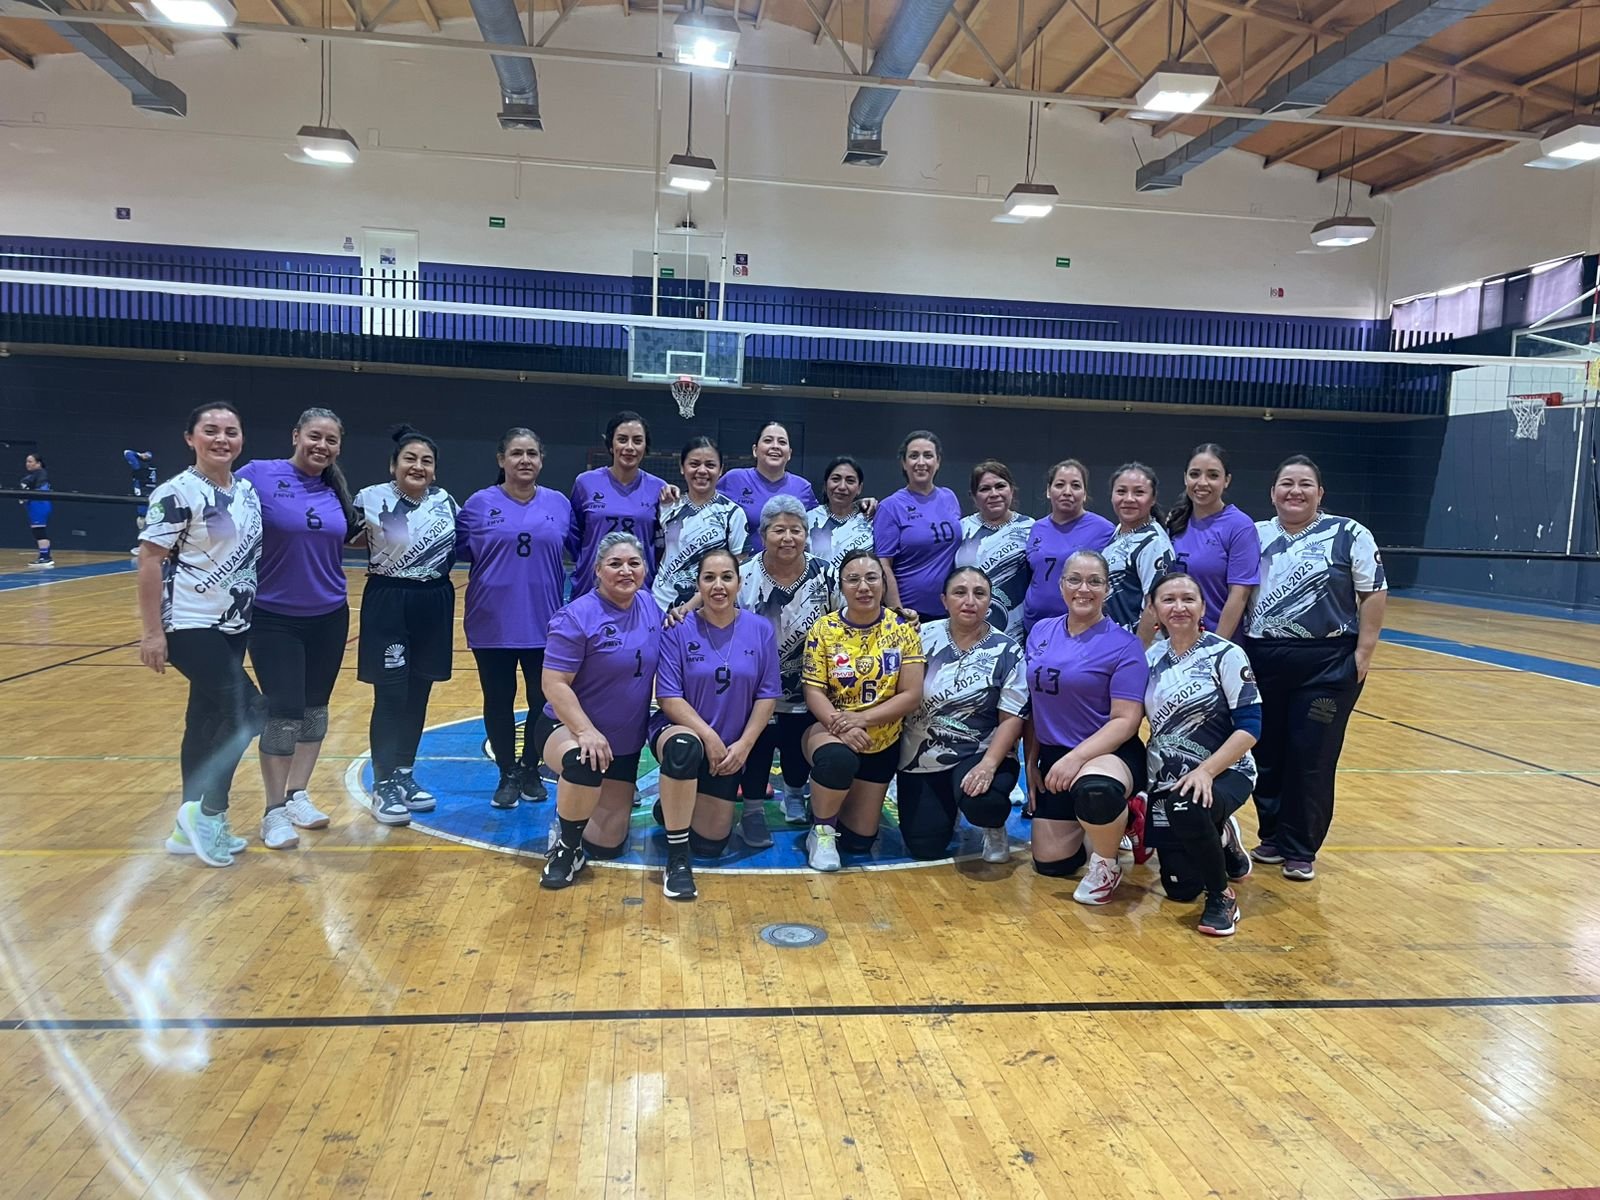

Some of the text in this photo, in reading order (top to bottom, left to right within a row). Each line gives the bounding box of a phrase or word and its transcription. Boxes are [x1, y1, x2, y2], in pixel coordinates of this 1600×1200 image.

[305, 506, 322, 530] 6
[516, 532, 533, 558] 8
[930, 521, 955, 544] 10
[979, 541, 1019, 571] UA-2025
[1044, 557, 1057, 582] 7
[634, 649, 642, 678] 1
[715, 666, 731, 695] 9
[862, 680, 877, 704] 6
[1034, 665, 1061, 695] 13
